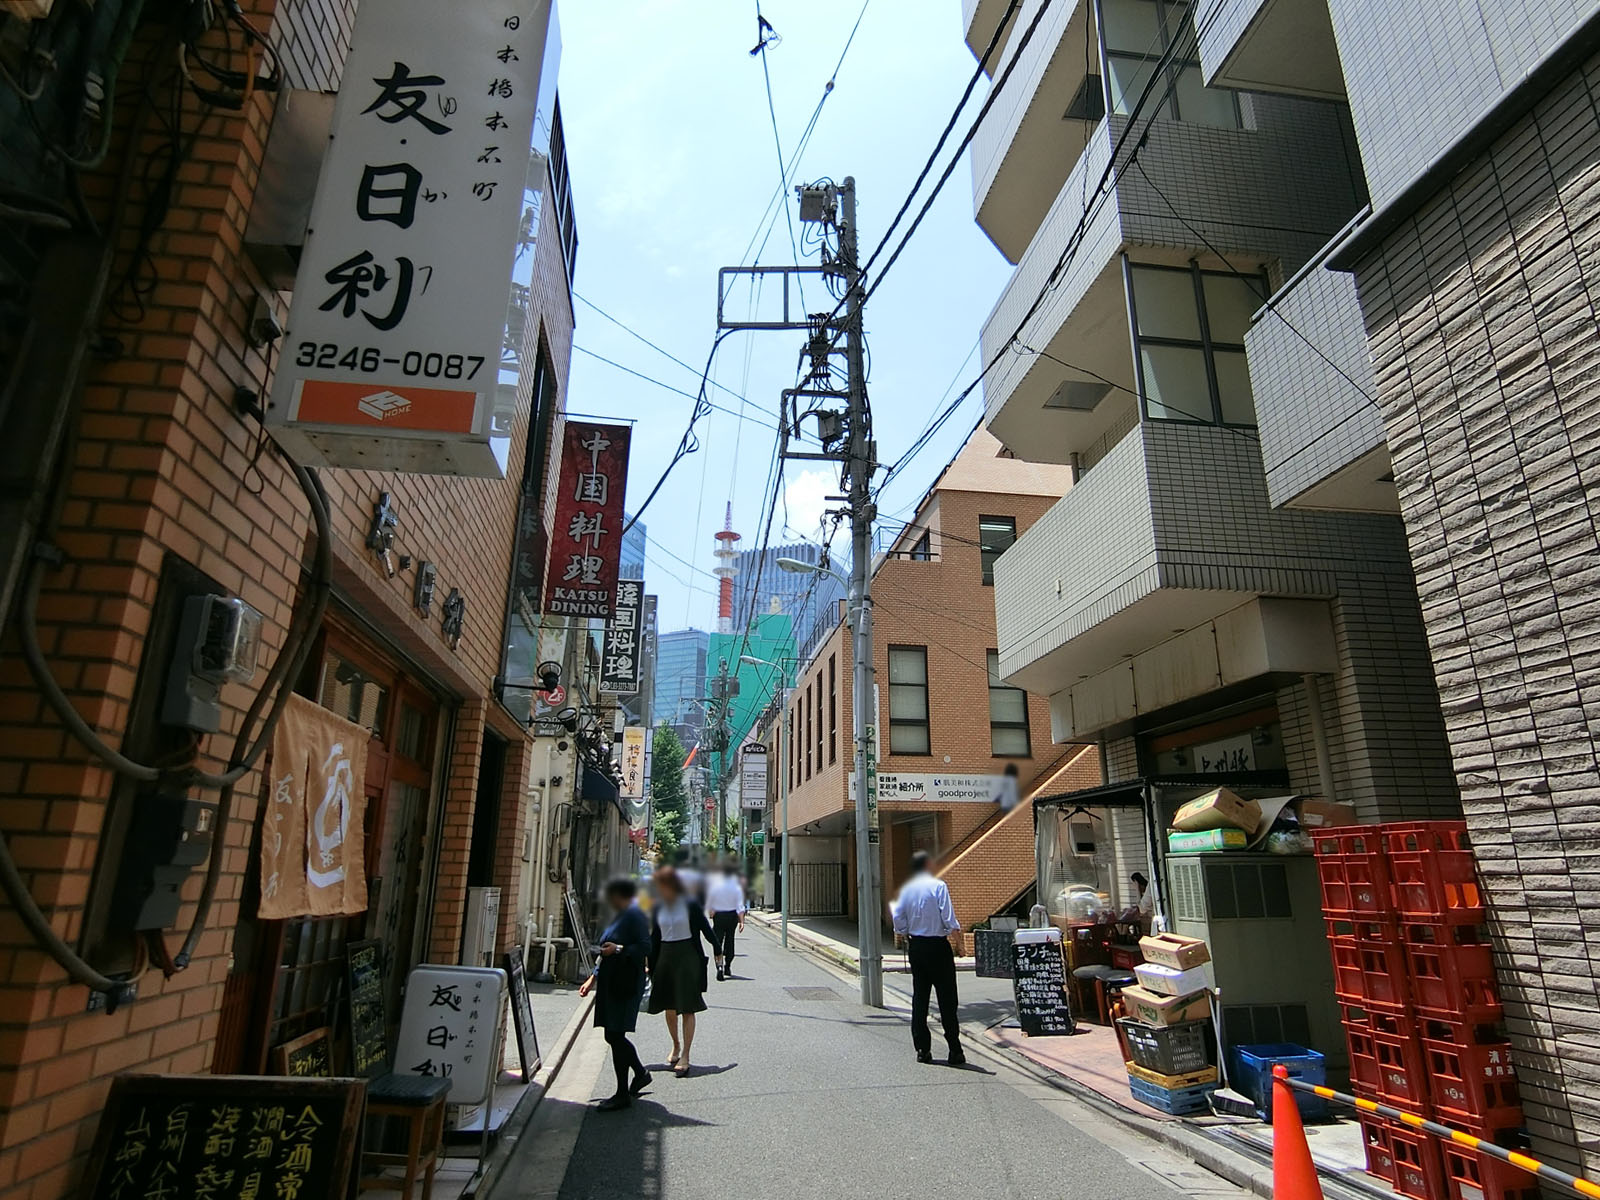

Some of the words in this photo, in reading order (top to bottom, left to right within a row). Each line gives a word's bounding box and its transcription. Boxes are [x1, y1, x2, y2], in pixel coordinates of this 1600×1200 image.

[472, 14, 521, 202] 日本橋本石町
[296, 341, 485, 381] 3246-0087
[384, 404, 412, 419] HOME
[562, 431, 611, 585] 中国料理
[554, 587, 608, 602] KATSU
[551, 600, 610, 616] DINING
[605, 582, 638, 679] 韓国料理
[899, 782, 924, 792] 紹介所
[937, 789, 990, 799] goodproject
[1017, 945, 1050, 959] ランチ
